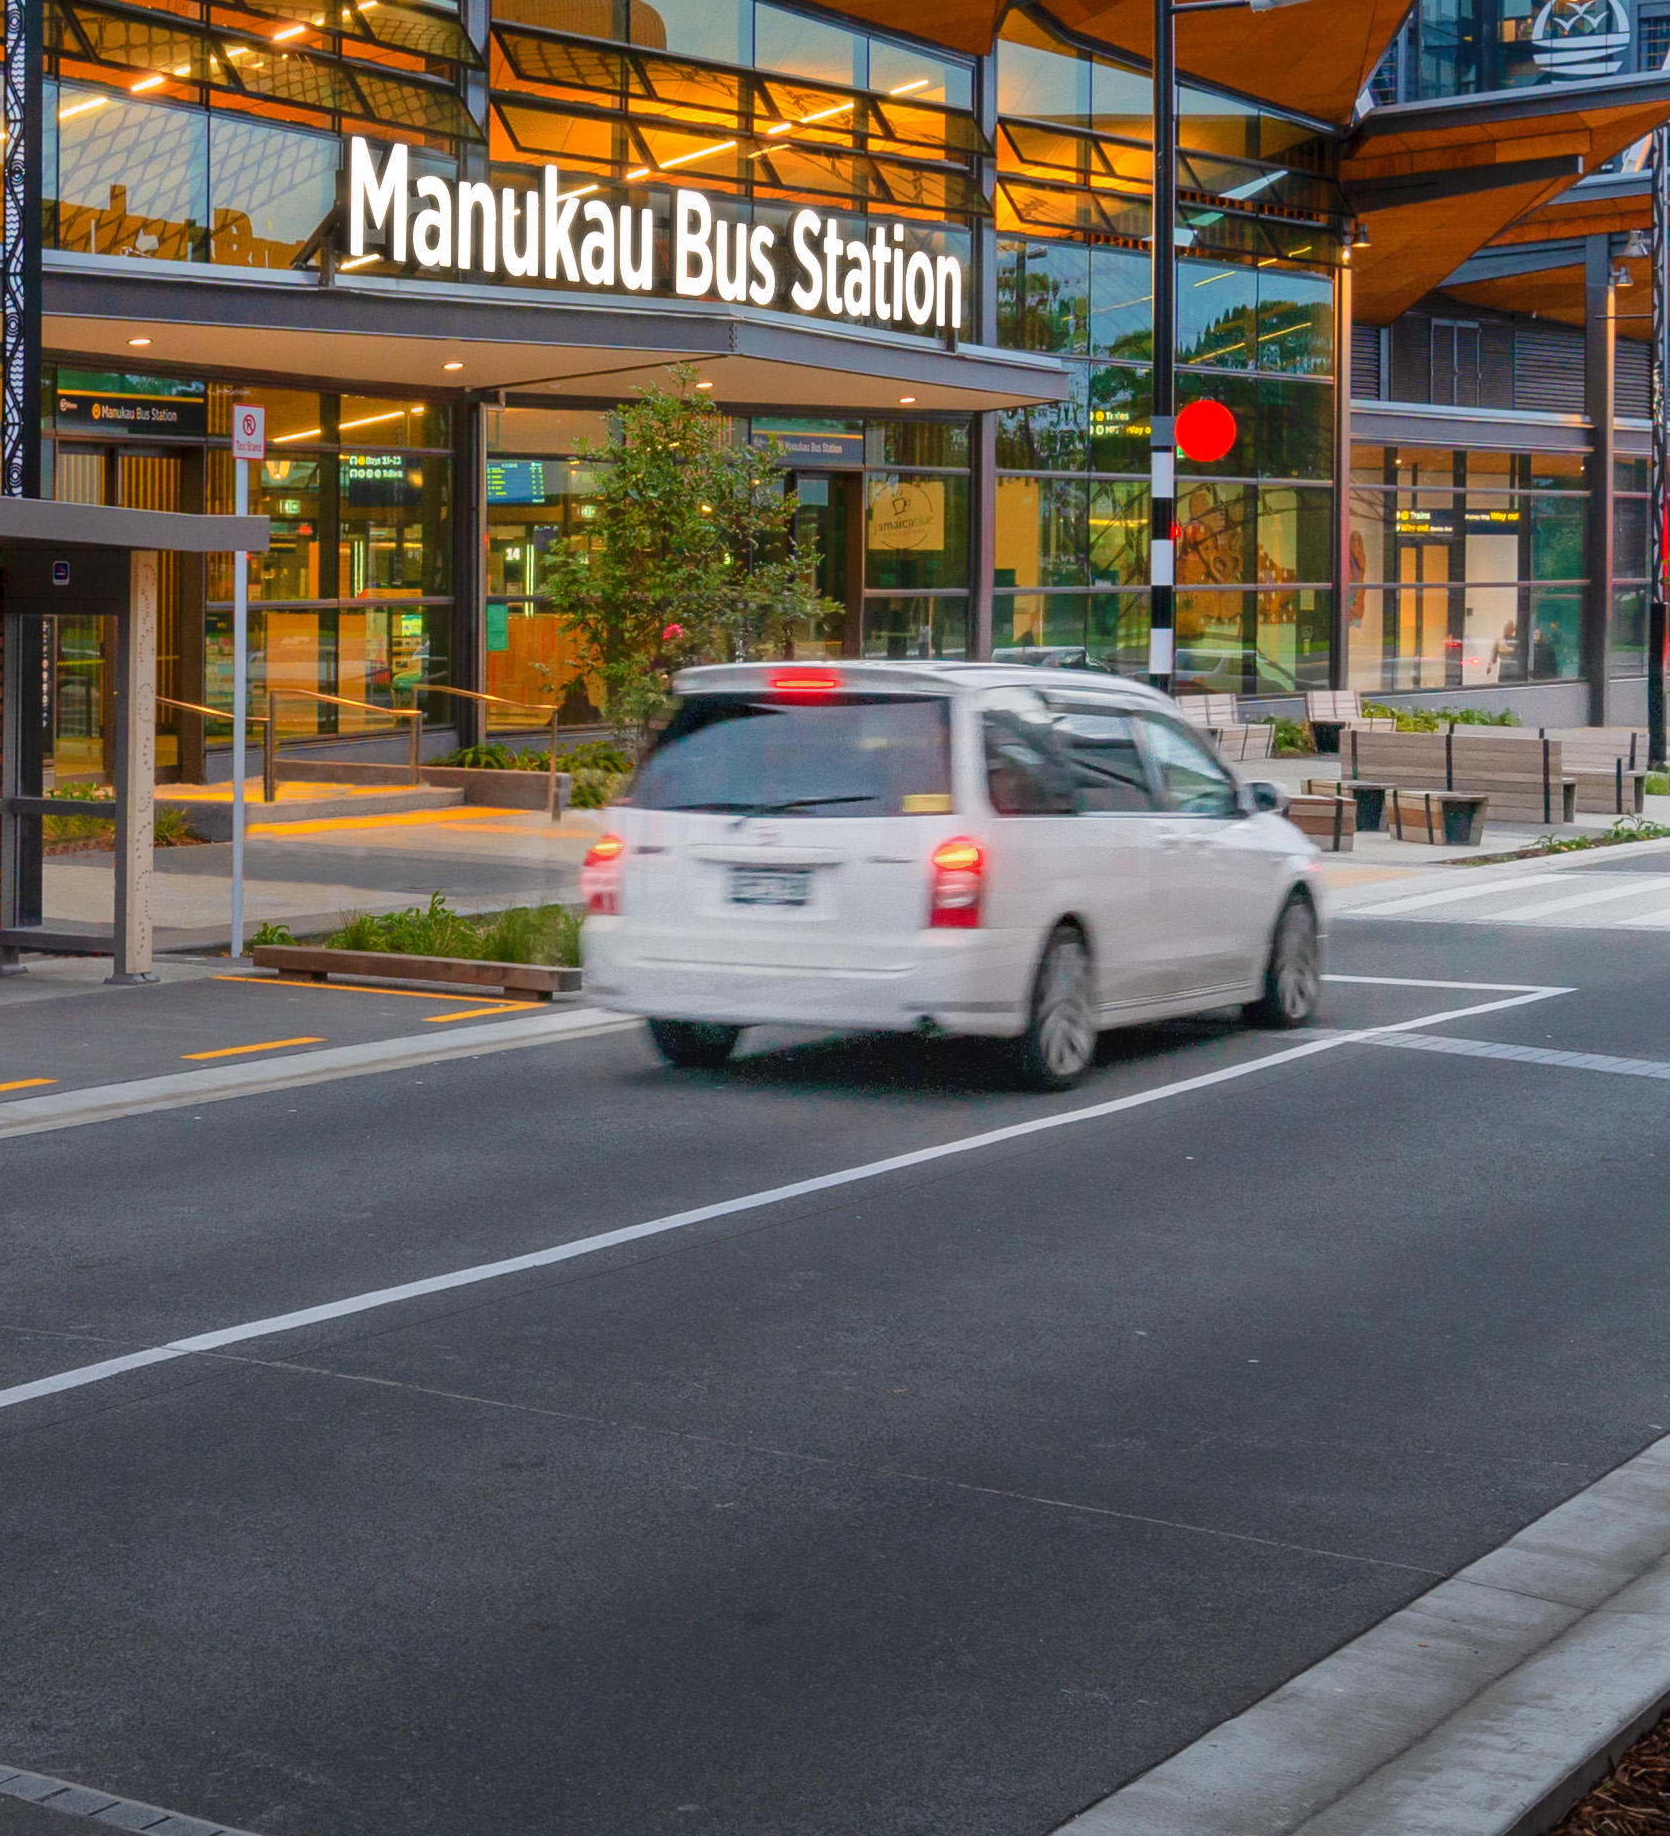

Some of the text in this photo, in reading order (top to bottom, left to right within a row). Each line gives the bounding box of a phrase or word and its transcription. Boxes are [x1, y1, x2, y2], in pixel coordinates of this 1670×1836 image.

[349, 136, 655, 292] Manukau
[673, 188, 776, 306] Bus
[791, 208, 962, 329] Station
[102, 405, 177, 422] Manukau Bus Station
[247, 441, 262, 452] Stand
[811, 442, 821, 453] Bus
[822, 442, 843, 454] Station
[505, 547, 520, 561] 14
